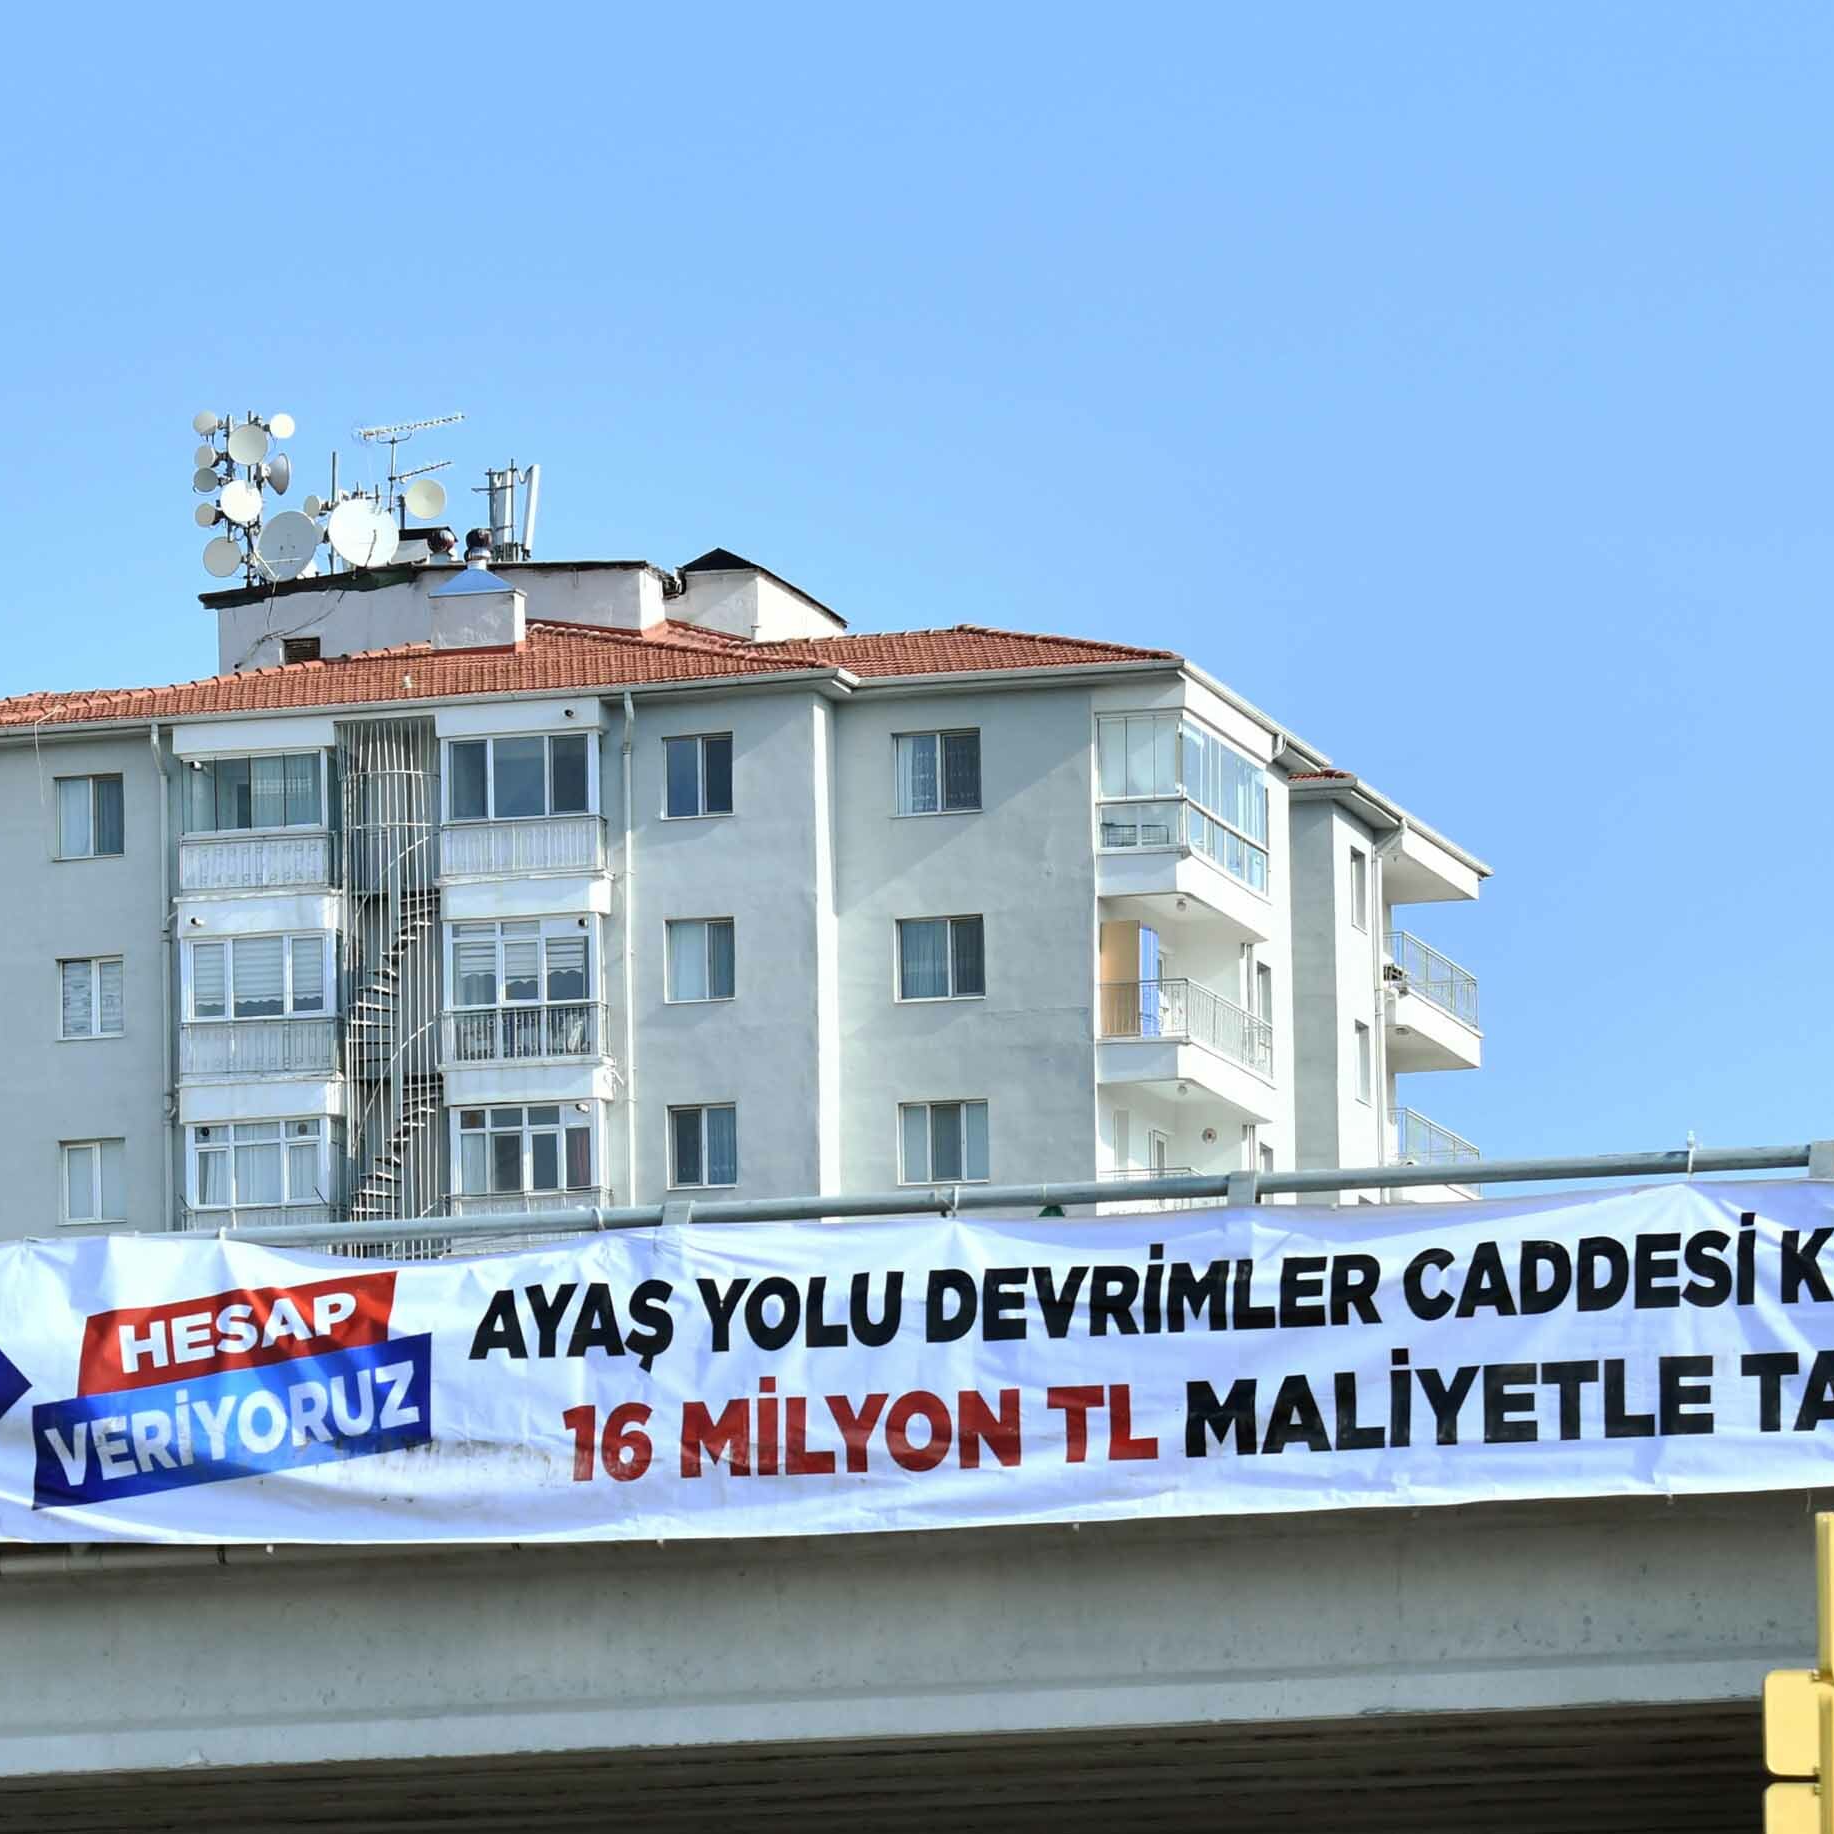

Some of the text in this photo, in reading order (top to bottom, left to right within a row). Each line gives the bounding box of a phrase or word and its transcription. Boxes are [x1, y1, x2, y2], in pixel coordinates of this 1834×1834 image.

[119, 1291, 358, 1374] HESAP
[469, 1279, 674, 1373] AYAŞ
[696, 1271, 904, 1353] YOLU
[925, 1243, 1382, 1343] DEVRİMLER
[1403, 1212, 1756, 1321] CADDESİ
[43, 1360, 421, 1488] VERİYORUZ
[564, 1404, 652, 1480] 16
[682, 1377, 1020, 1477] MİLYON
[1048, 1385, 1157, 1463] TL
[1185, 1348, 1714, 1458] MALİYETLE
